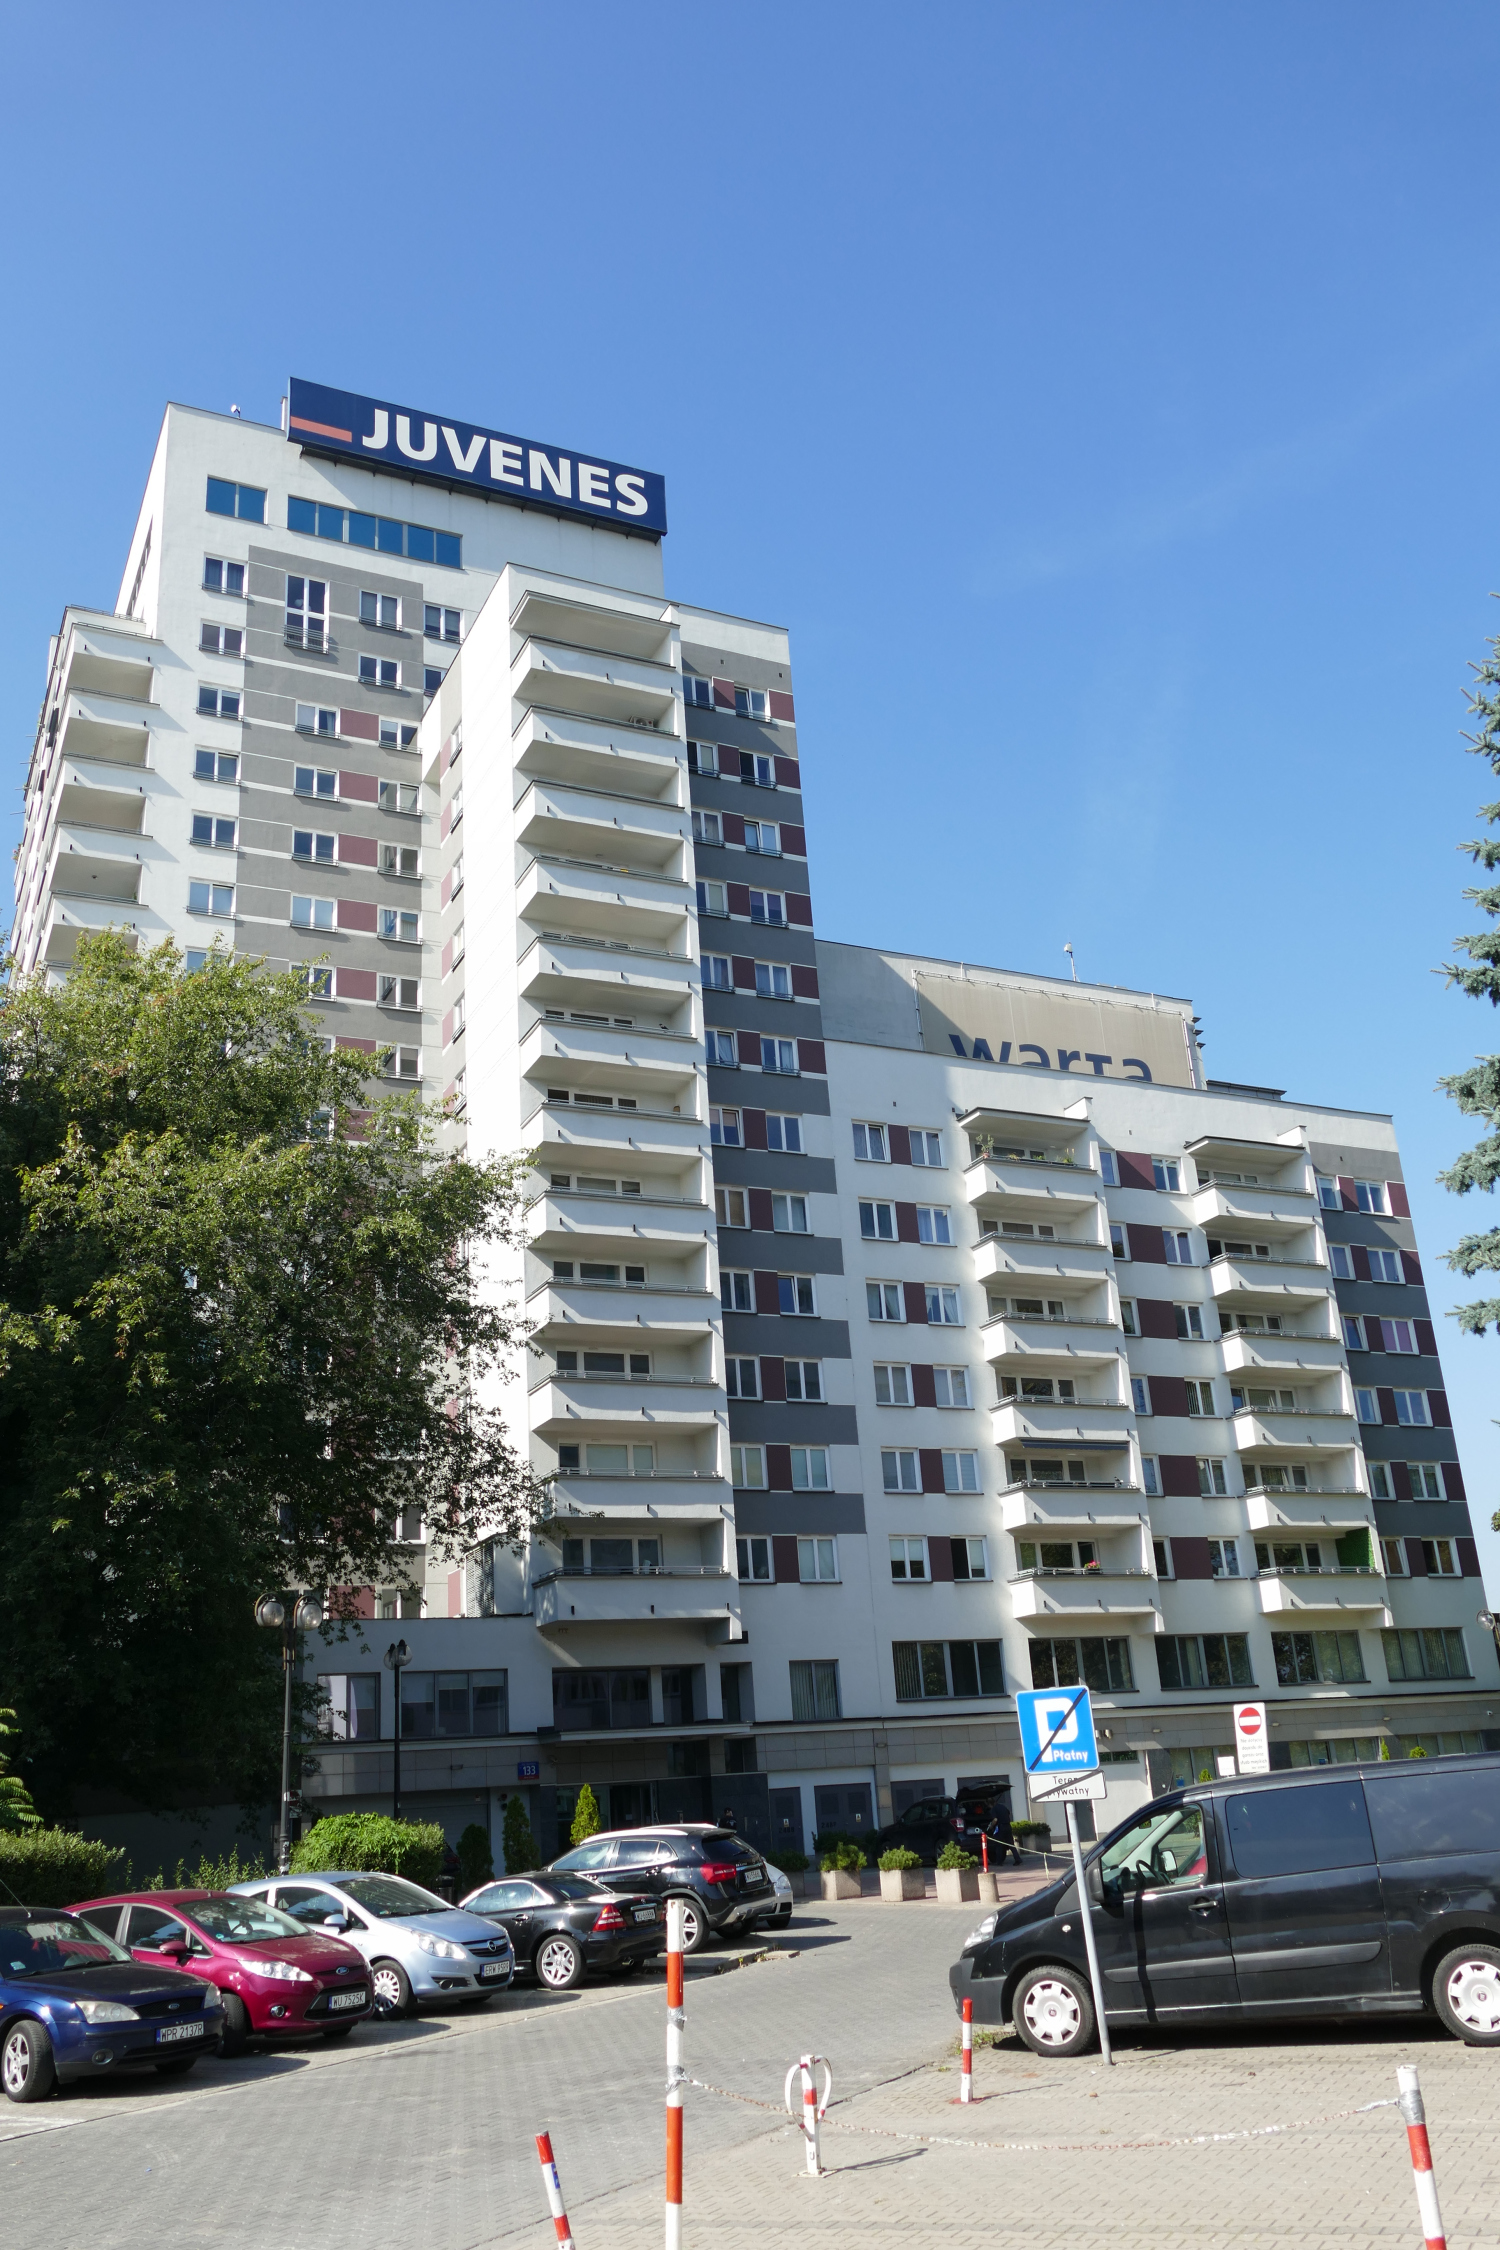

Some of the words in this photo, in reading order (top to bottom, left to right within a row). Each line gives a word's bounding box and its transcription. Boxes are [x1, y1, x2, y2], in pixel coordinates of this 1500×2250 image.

[362, 408, 649, 516] JUVENES
[1034, 1697, 1079, 1763] P
[1053, 1749, 1088, 1763] Płatny
[523, 1765, 536, 1776] 133
[333, 1996, 344, 2007] WU
[344, 1992, 365, 2006] 7525K
[161, 2028, 178, 2042] WPR
[179, 2023, 203, 2038] 2137R
